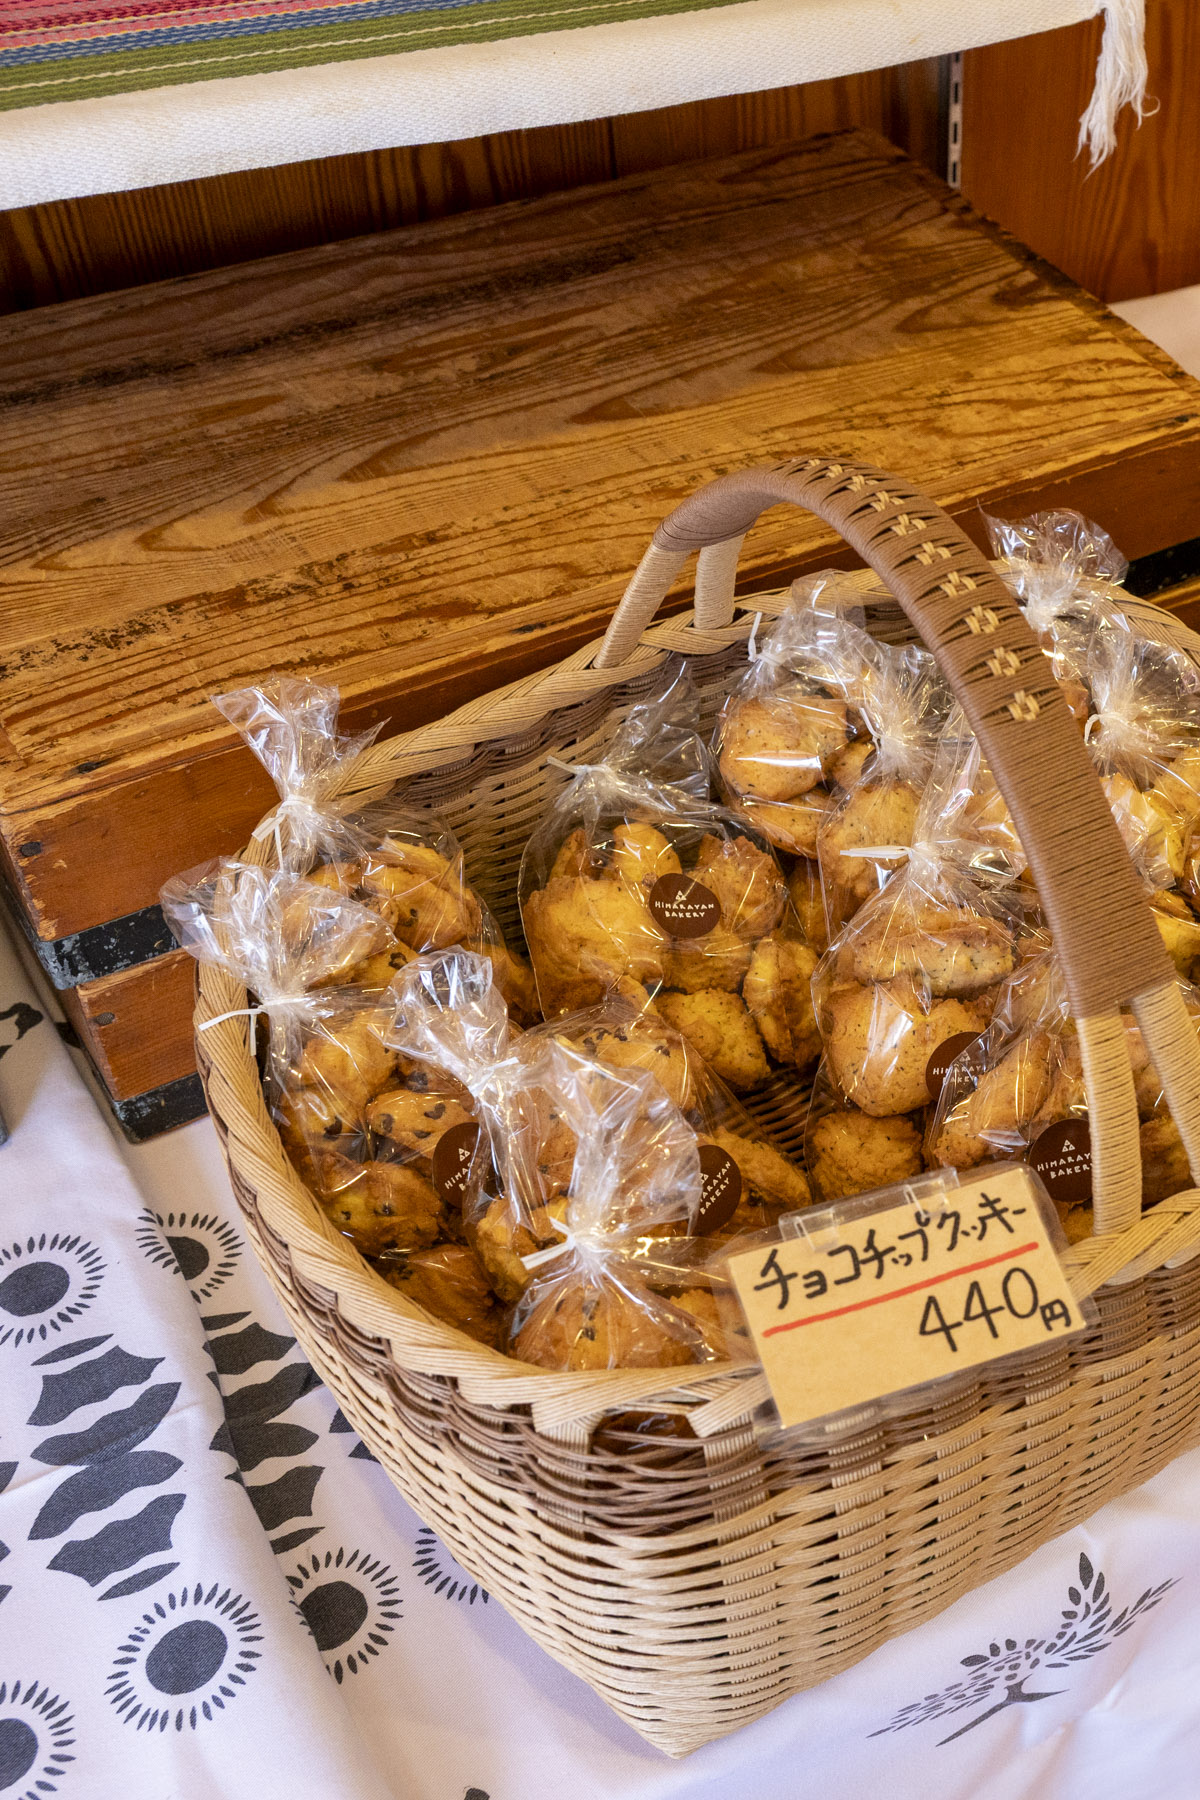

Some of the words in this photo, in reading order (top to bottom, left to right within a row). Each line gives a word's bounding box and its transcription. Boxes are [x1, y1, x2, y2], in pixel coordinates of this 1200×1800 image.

[664, 910, 706, 919] BAKERY
[1050, 1163, 1093, 1179] BAKER
[753, 1192, 1027, 1311] チョコチップクッキー
[918, 1267, 1072, 1352] 440円
